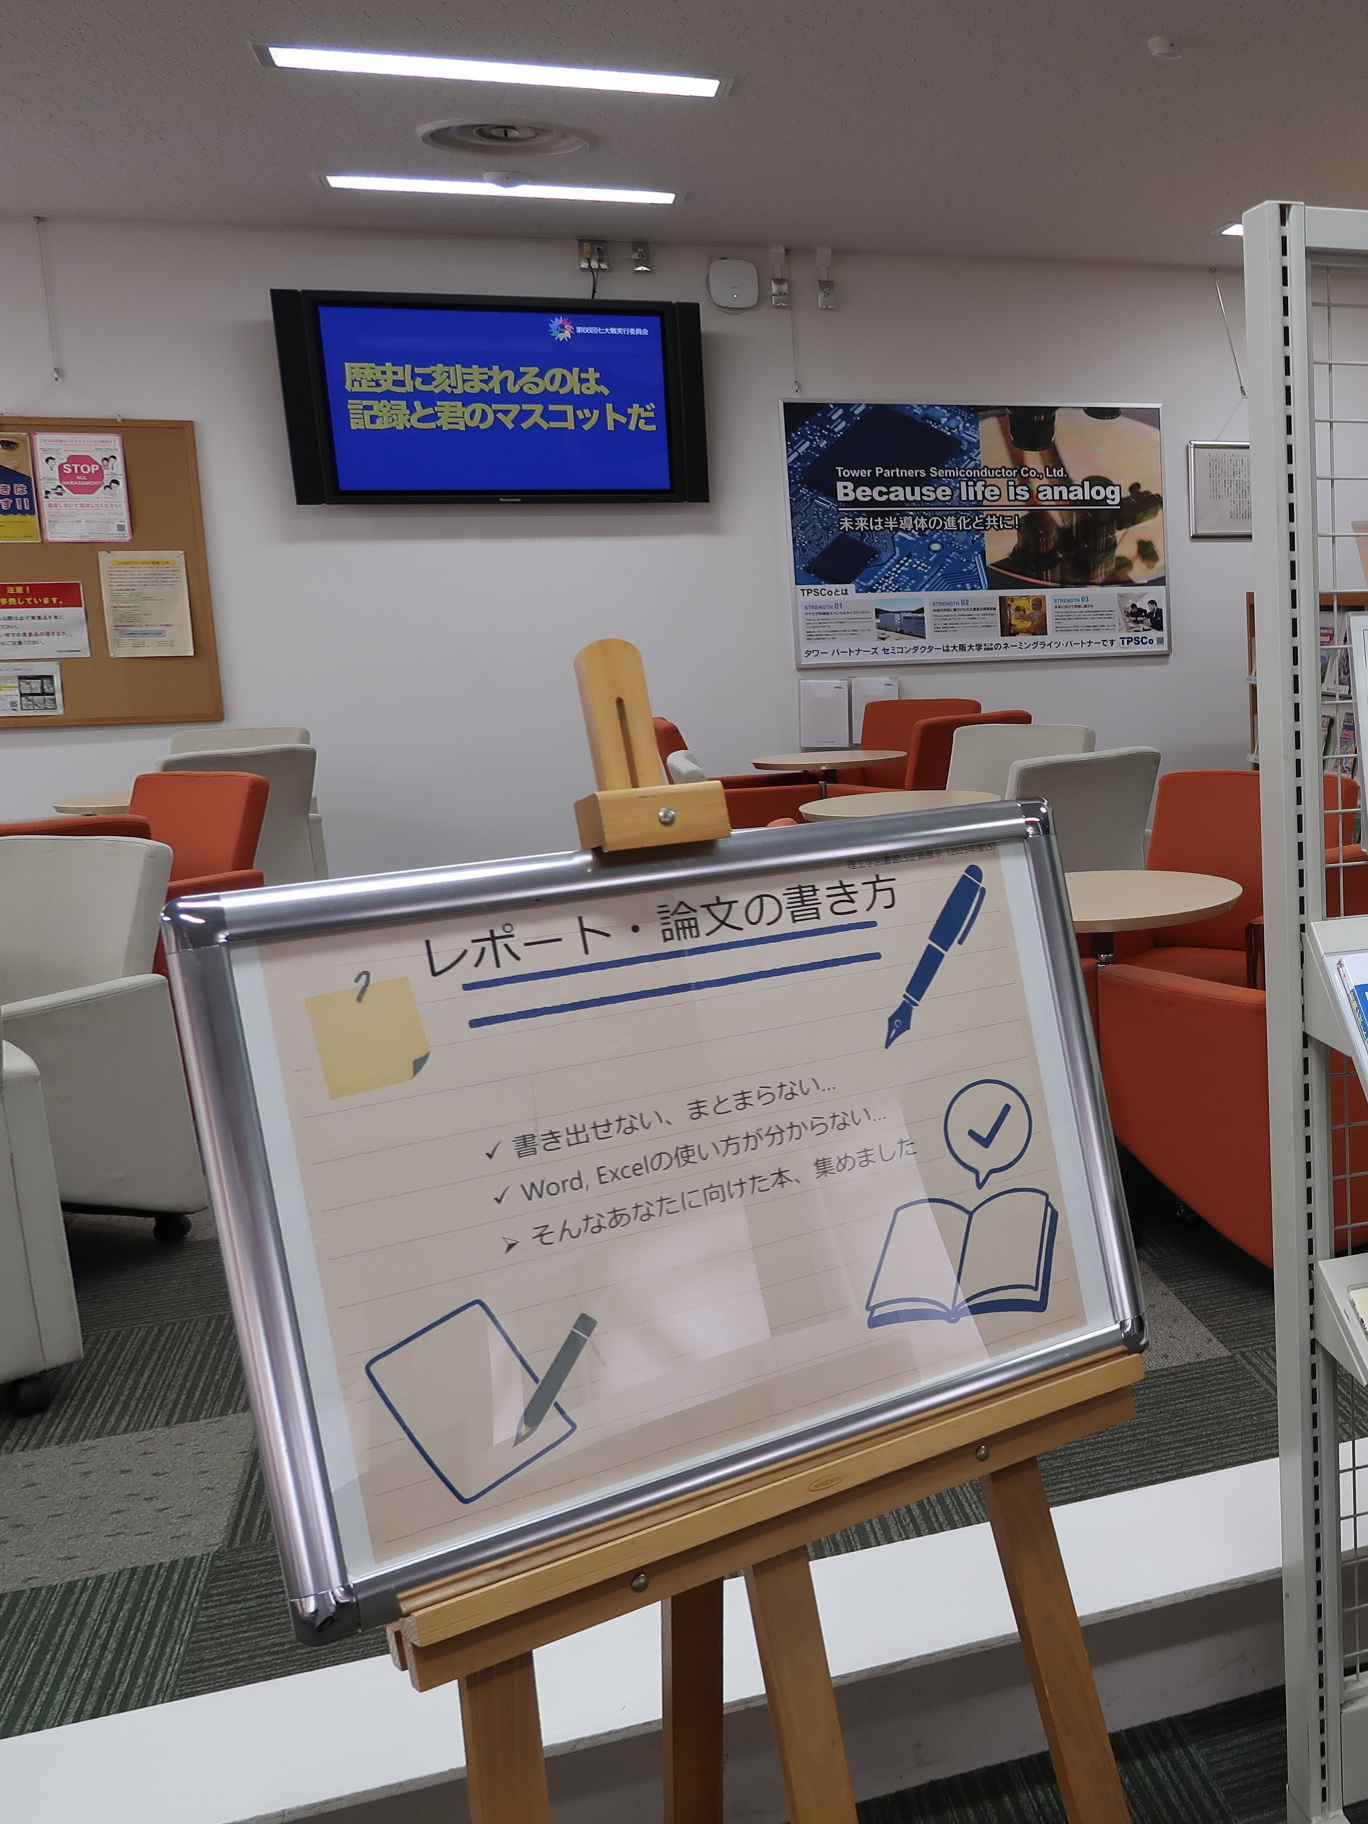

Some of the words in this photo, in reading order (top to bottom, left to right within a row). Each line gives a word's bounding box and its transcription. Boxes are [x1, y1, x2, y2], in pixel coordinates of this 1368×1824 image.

[345, 362, 610, 396] 歴史に刻まれるのは、
[347, 399, 657, 431] 記録と君のマスコットだ
[63, 464, 100, 474] STOP
[836, 466, 872, 478] Tower
[875, 467, 926, 478] Partners
[929, 467, 1018, 478] Semiconductor
[1020, 467, 1043, 480] Co.,
[1046, 467, 1068, 478] Ltd.
[836, 480, 953, 502] Because
[960, 480, 1000, 502] life
[1007, 480, 1030, 502] is
[1037, 480, 1122, 506] analog
[838, 514, 1020, 532] 未来は半導体の進化と共に!
[800, 588, 849, 597] TPSCoとは
[804, 650, 828, 658] タワー
[831, 646, 879, 657] パートナーズ
[1120, 636, 1154, 646] TPSCo
[422, 873, 898, 979] レポート・論文の書き方
[512, 1075, 837, 1162] 書き出せない、まとまらない…
[521, 1163, 591, 1203] Word,
[531, 1134, 918, 1247] そんなあなたに向けた本、集めました
